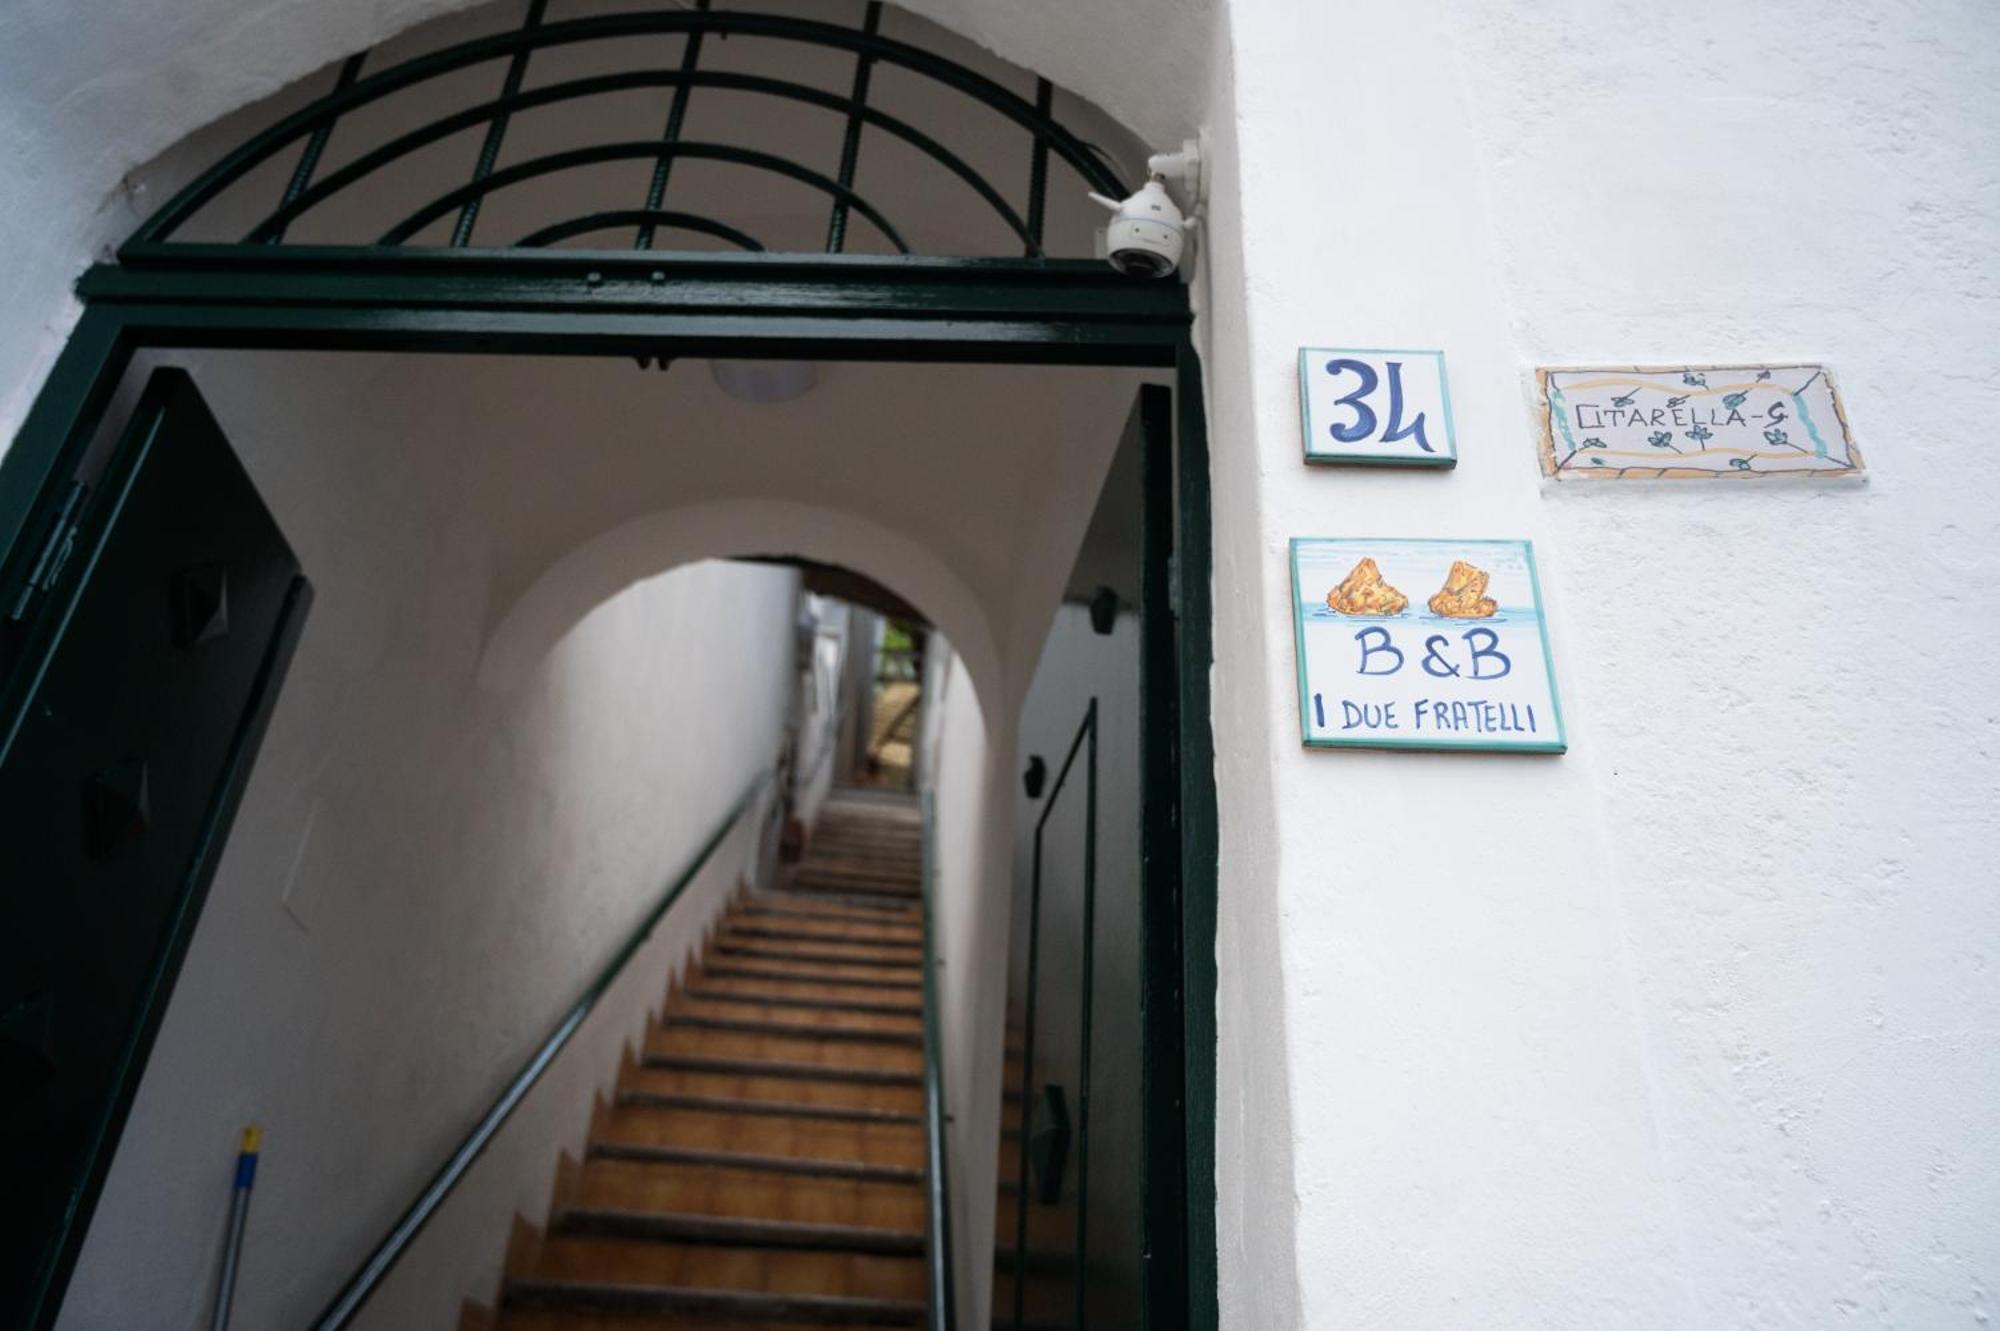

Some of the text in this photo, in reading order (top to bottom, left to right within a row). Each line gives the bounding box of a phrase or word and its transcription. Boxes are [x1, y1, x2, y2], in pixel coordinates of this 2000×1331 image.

[1326, 358, 1436, 453] 34
[1314, 693, 1536, 733] I DUE FRATELLI
